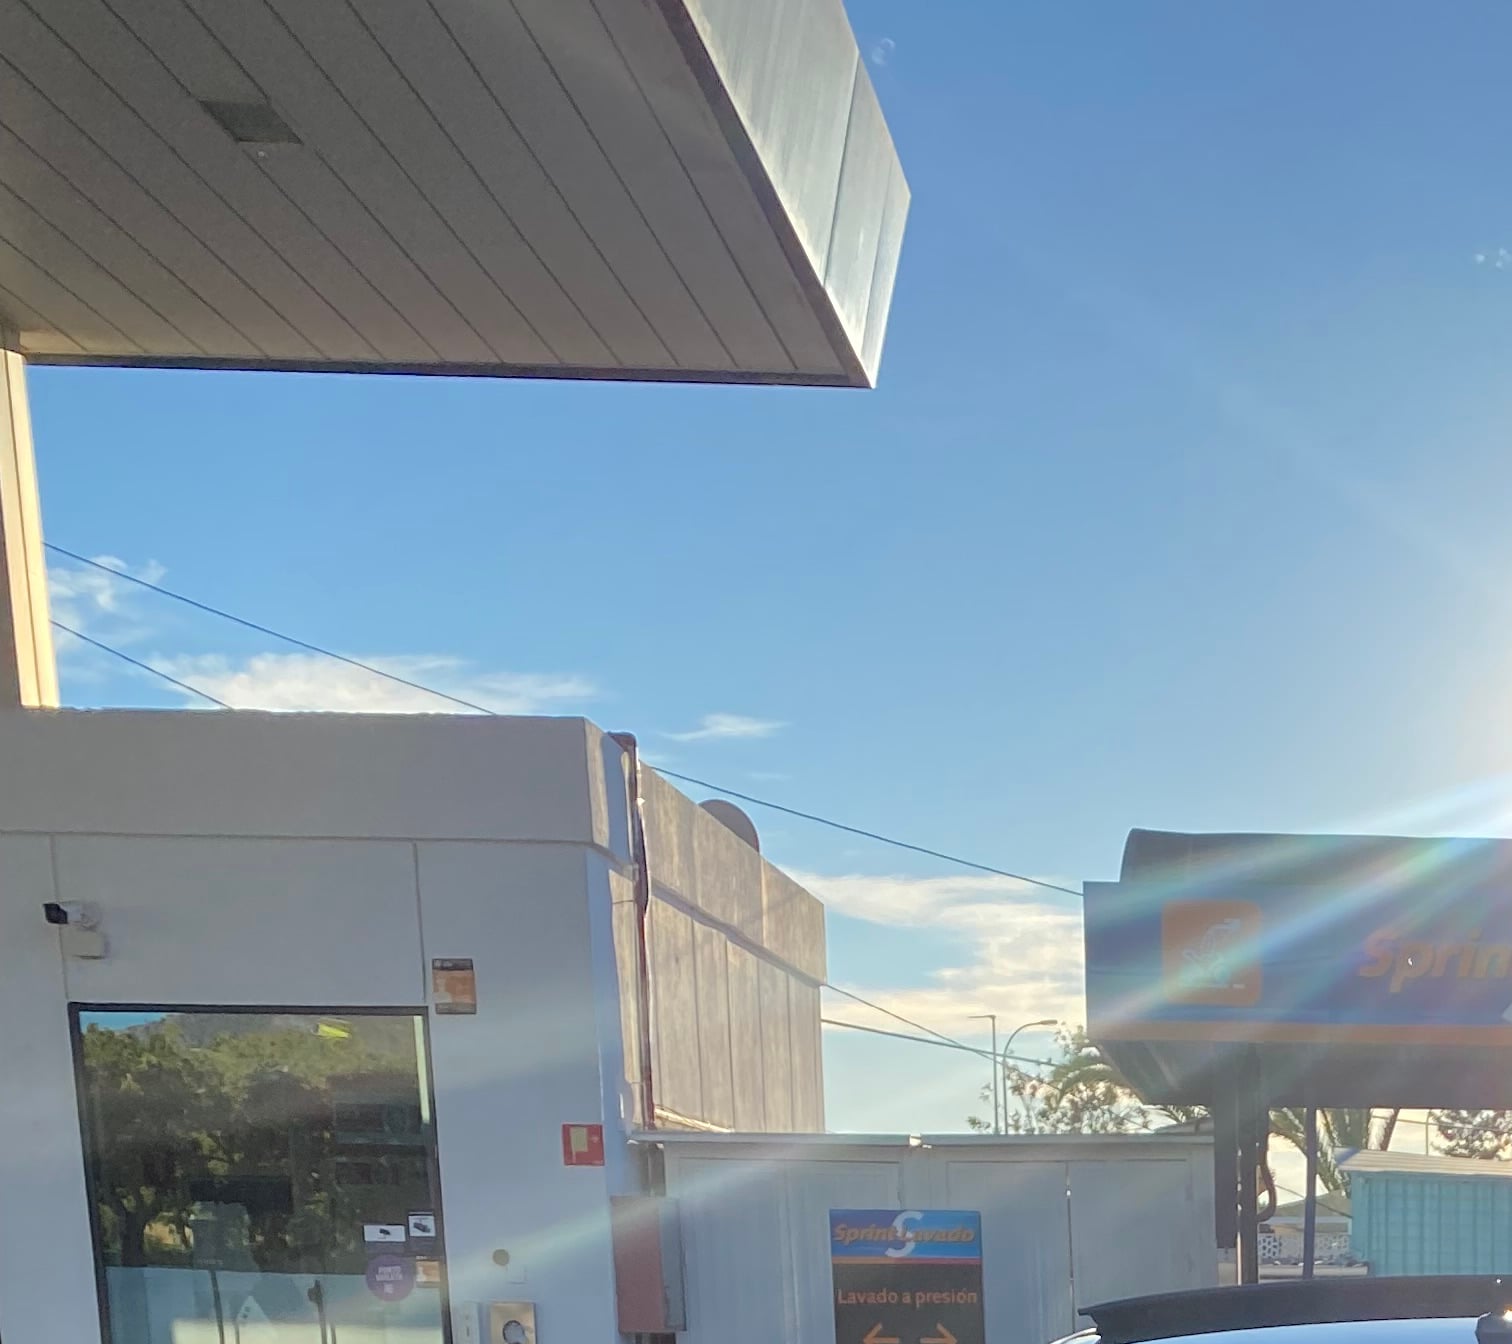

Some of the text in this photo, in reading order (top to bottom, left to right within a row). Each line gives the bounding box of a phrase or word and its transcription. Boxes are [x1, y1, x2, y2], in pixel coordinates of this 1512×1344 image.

[834, 1224, 898, 1246] Sprint
[837, 1287, 978, 1309] Lavado a presión
